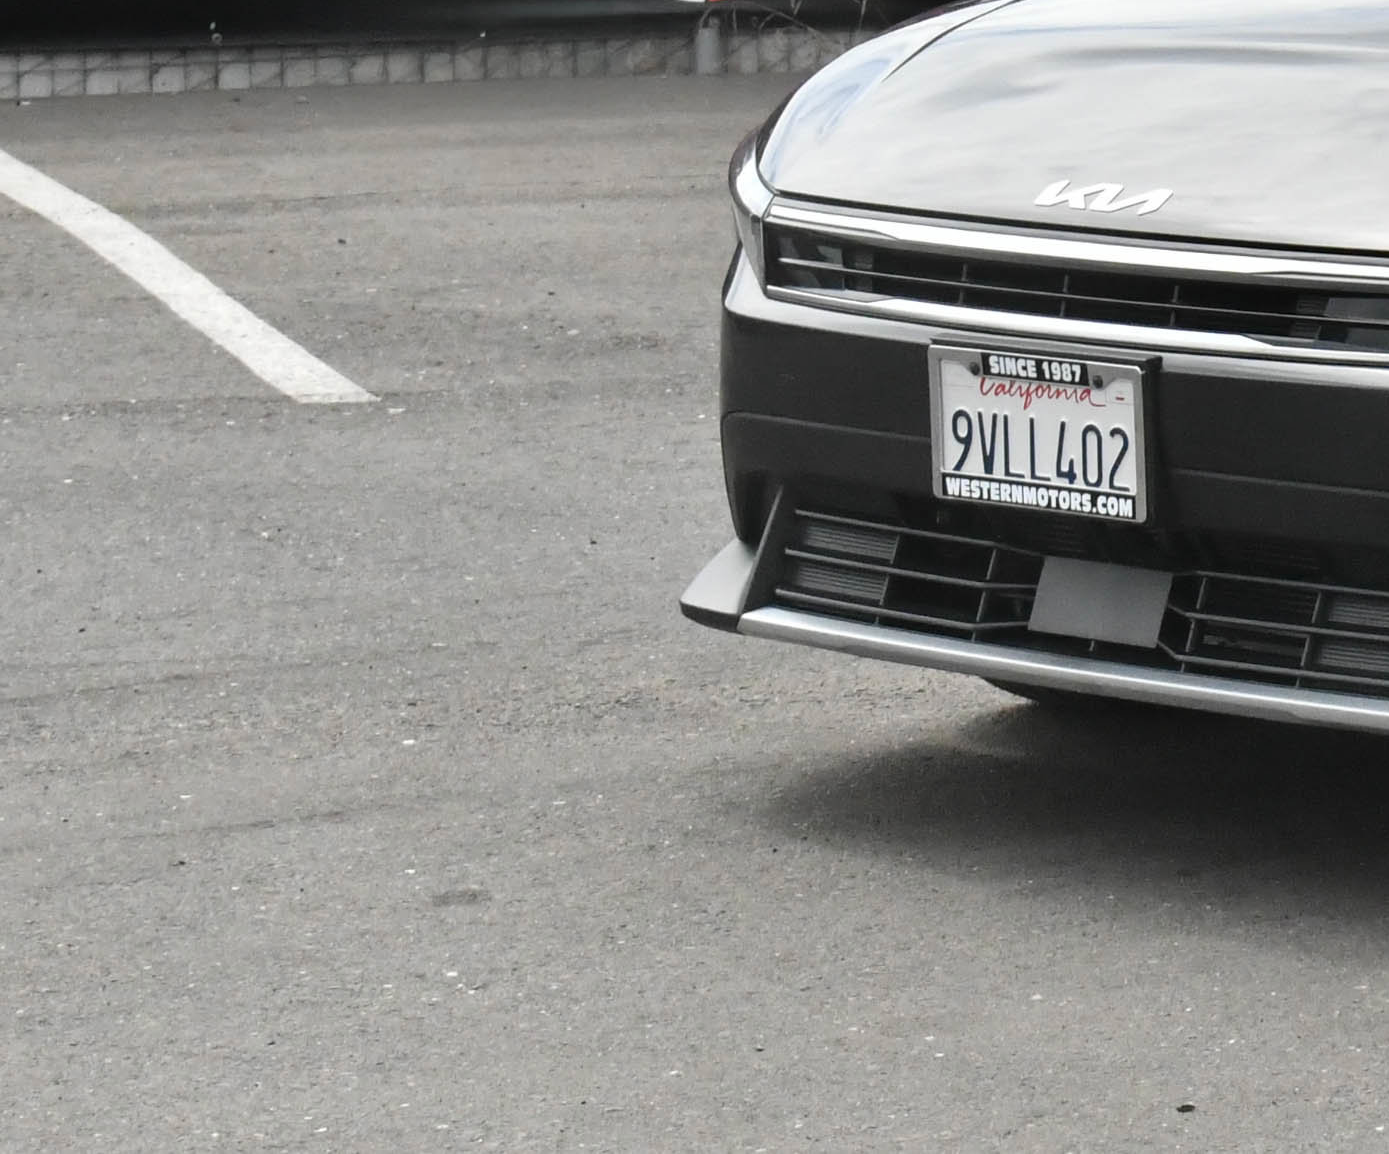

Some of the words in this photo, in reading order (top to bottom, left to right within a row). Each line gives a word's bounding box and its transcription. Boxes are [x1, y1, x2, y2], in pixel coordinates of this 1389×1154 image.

[1034, 179, 1174, 216] KIA
[988, 355, 1037, 378] SINCE
[1042, 361, 1081, 382] 1987
[979, 377, 1106, 410] California
[952, 409, 1130, 492] 9VLL402
[945, 477, 1133, 518] WESTERNMOTORS.COM
